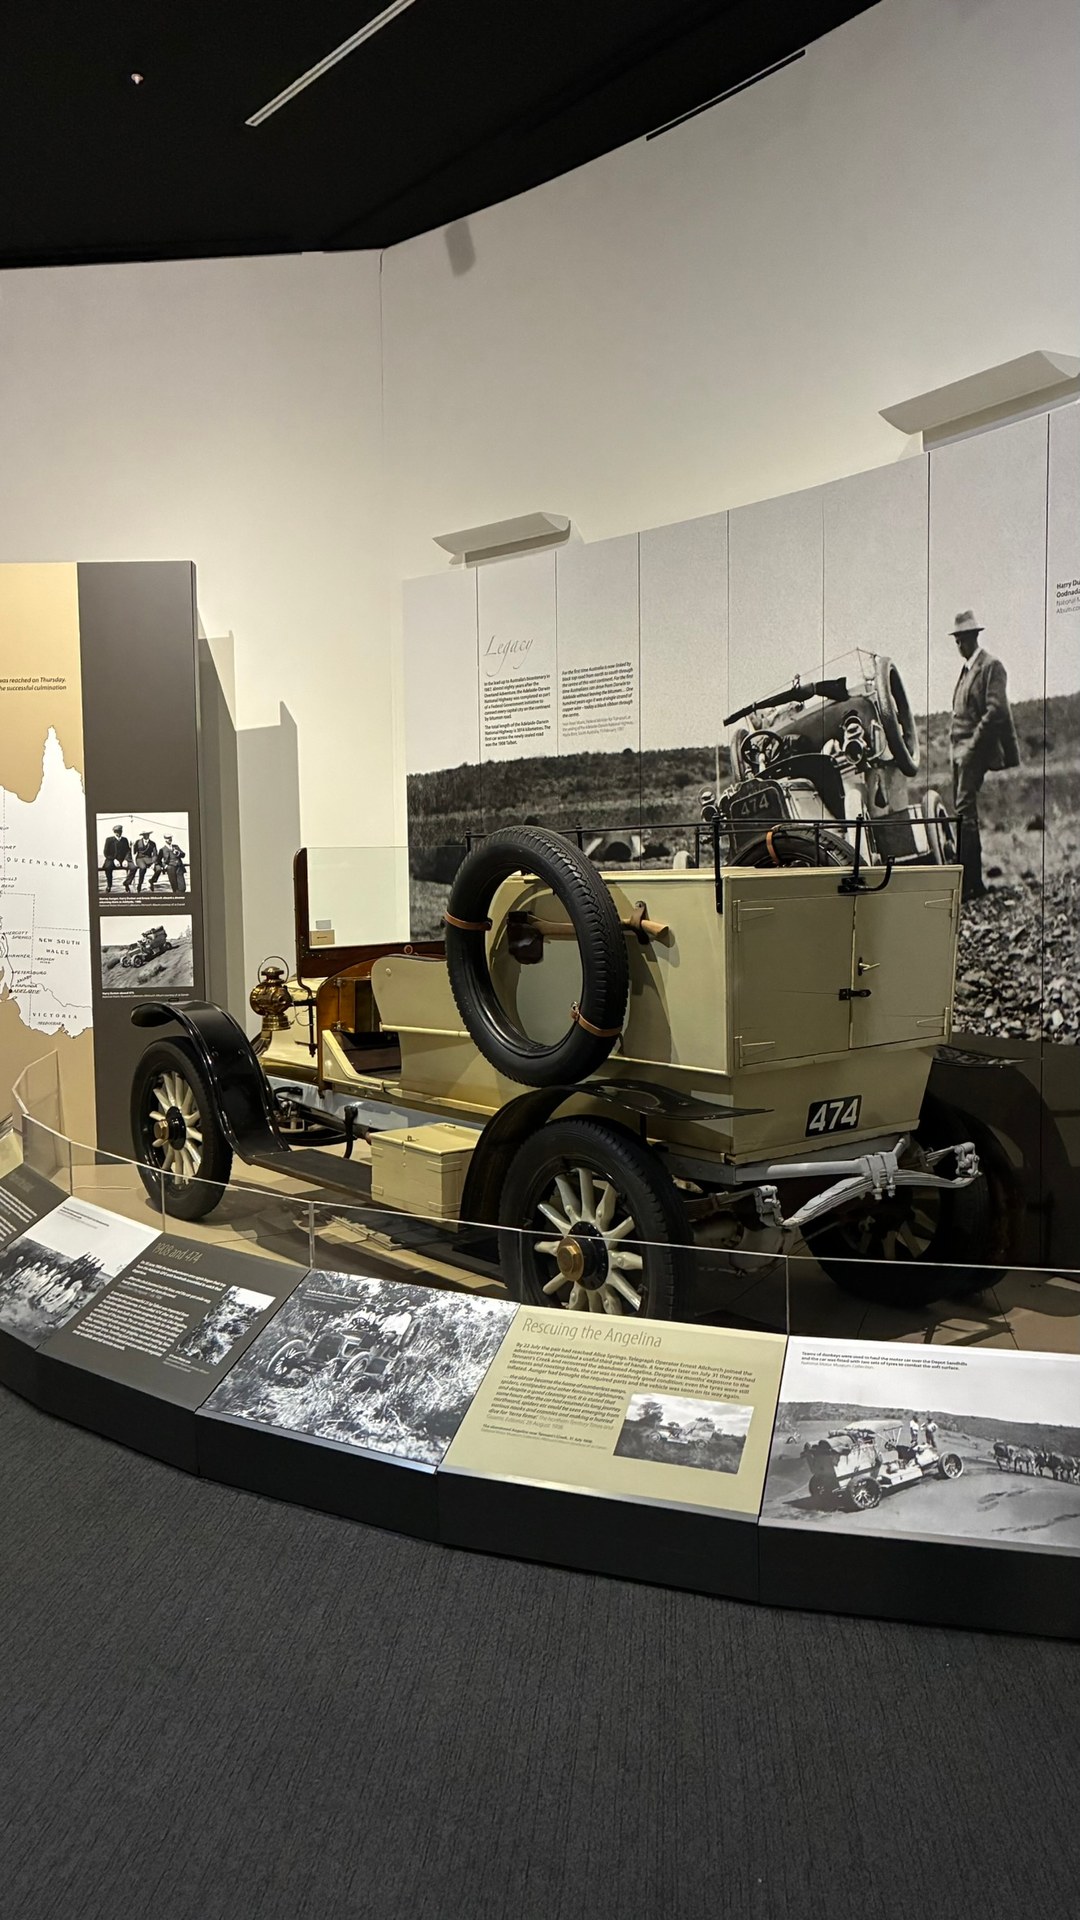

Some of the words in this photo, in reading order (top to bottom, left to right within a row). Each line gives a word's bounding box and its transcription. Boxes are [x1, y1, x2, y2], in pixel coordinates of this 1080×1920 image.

[483, 635, 533, 677] Legacy
[741, 793, 769, 814] 474
[7, 857, 78, 869] QUEENSLAND
[809, 1099, 858, 1131] 474
[152, 1242, 174, 1256] 1908
[169, 1249, 189, 1260] and
[185, 1251, 203, 1264] 474
[522, 1318, 578, 1340] Rescuing
[581, 1325, 602, 1340] the
[604, 1328, 662, 1348] Angelina
[629, 1356, 654, 1364] Telegraph
